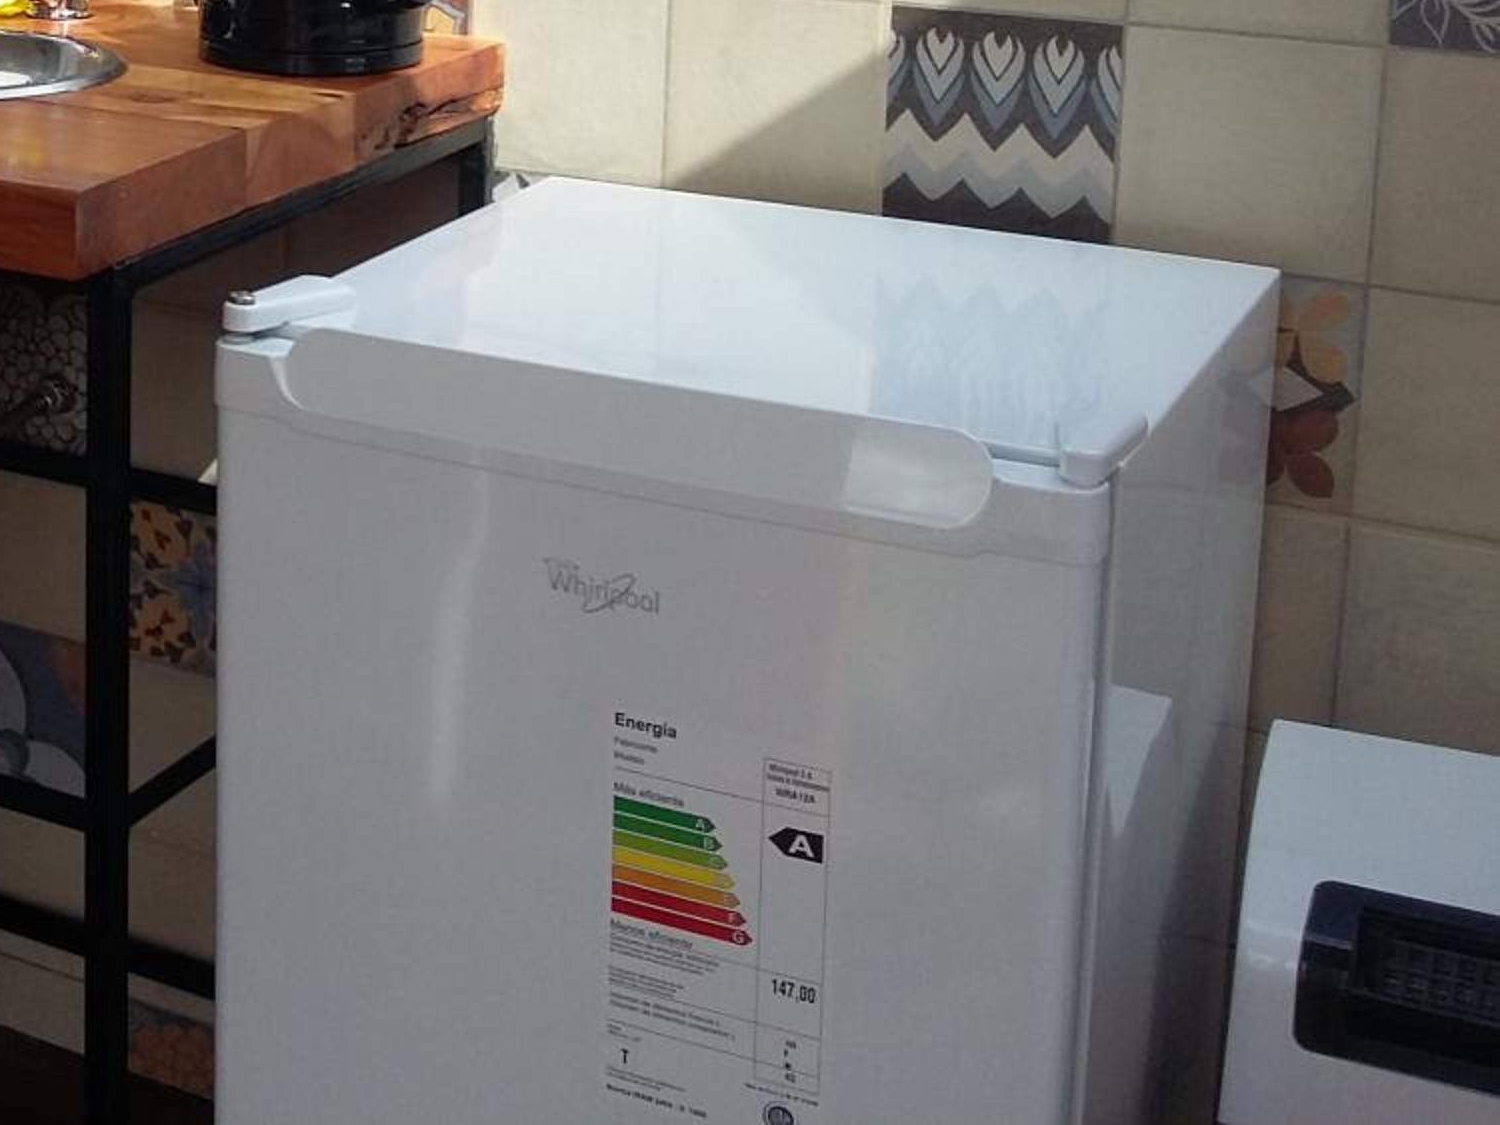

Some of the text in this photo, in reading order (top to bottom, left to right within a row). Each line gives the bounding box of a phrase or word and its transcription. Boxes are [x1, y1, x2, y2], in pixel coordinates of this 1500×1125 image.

[543, 557, 660, 615] Whirlpool
[695, 818, 706, 831] A
[788, 834, 815, 858] A
[731, 930, 745, 945] G
